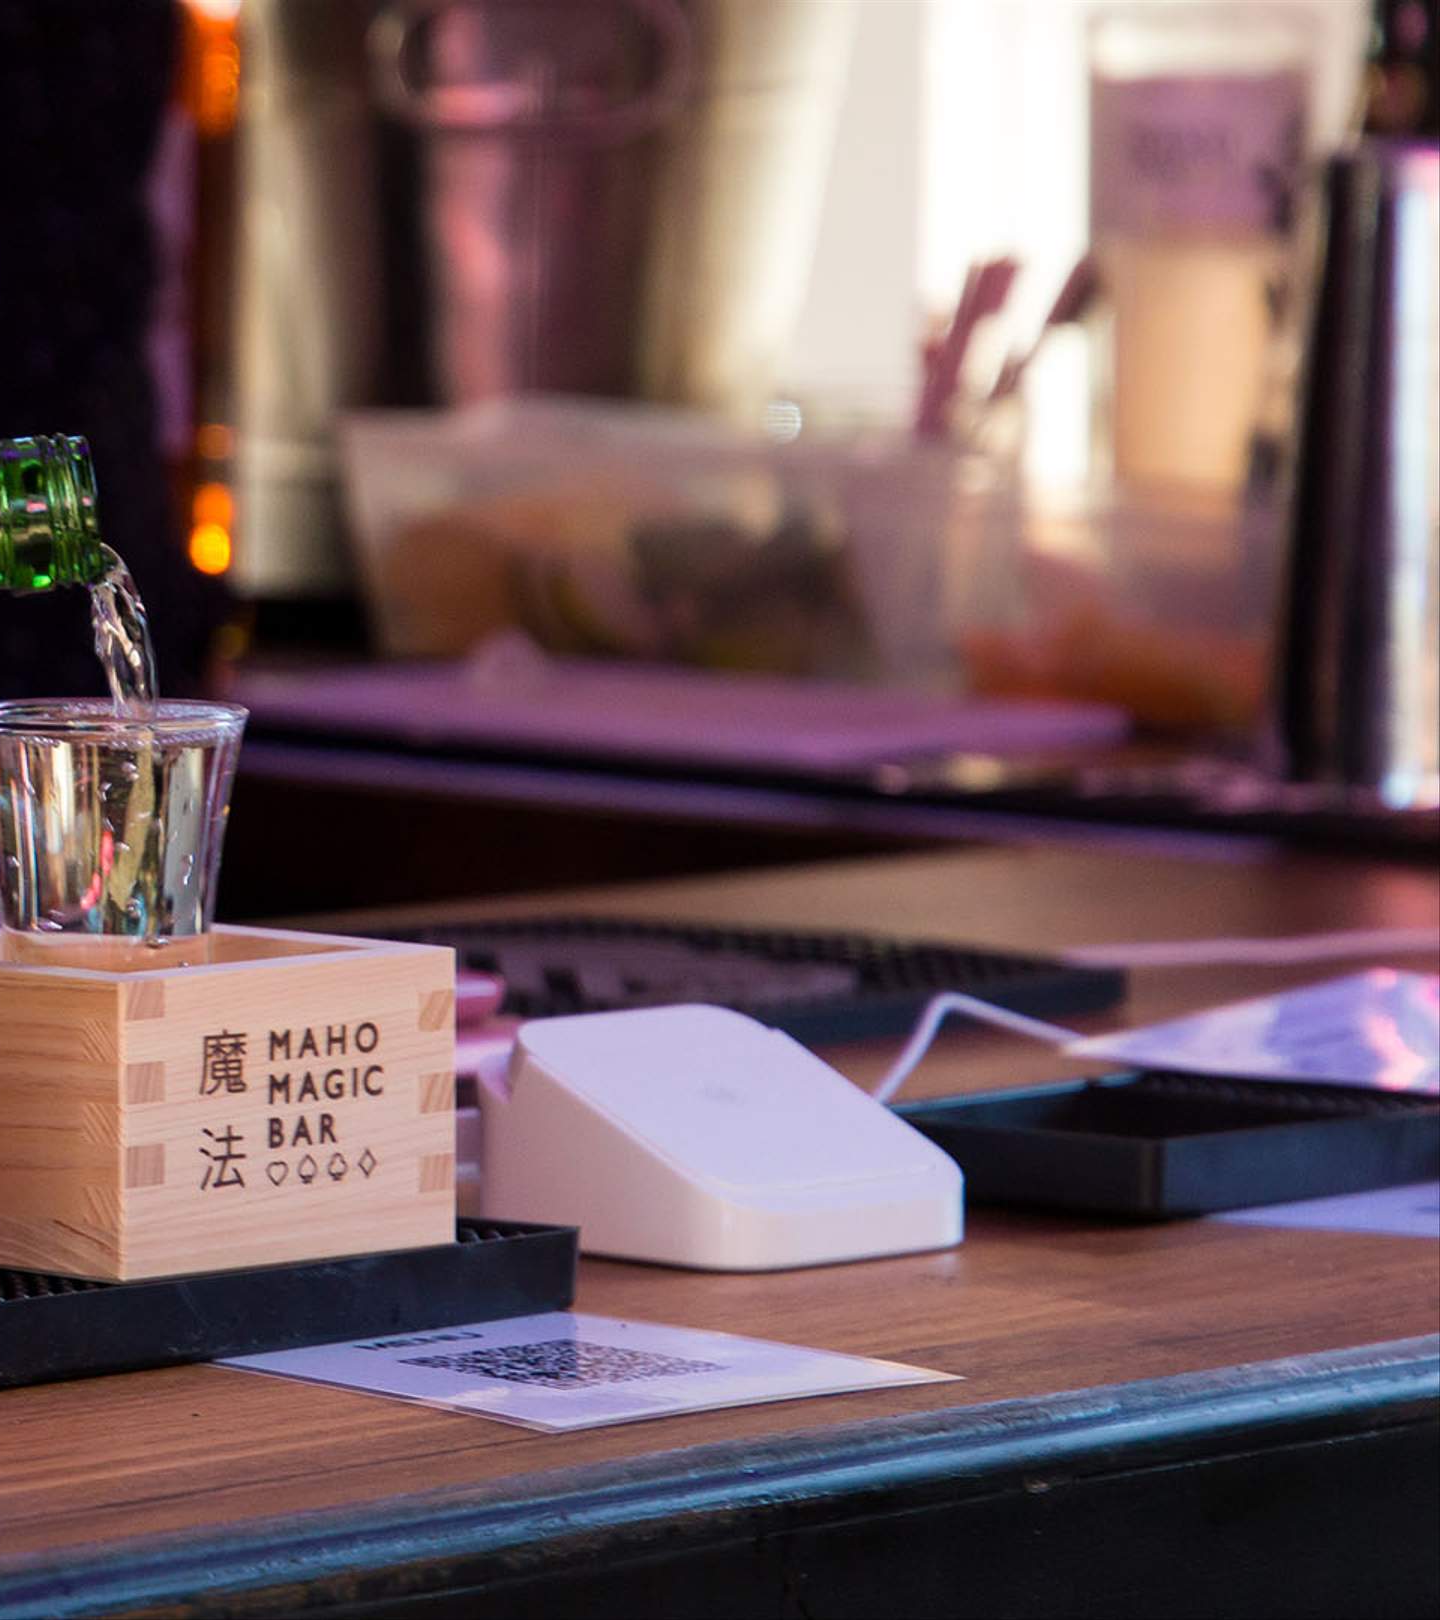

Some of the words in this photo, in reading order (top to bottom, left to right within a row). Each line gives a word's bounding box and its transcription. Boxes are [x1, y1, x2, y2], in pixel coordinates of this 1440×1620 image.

[268, 1021, 379, 1062] MAHO
[267, 1064, 385, 1105] MAGIC
[268, 1112, 338, 1149] BAR
